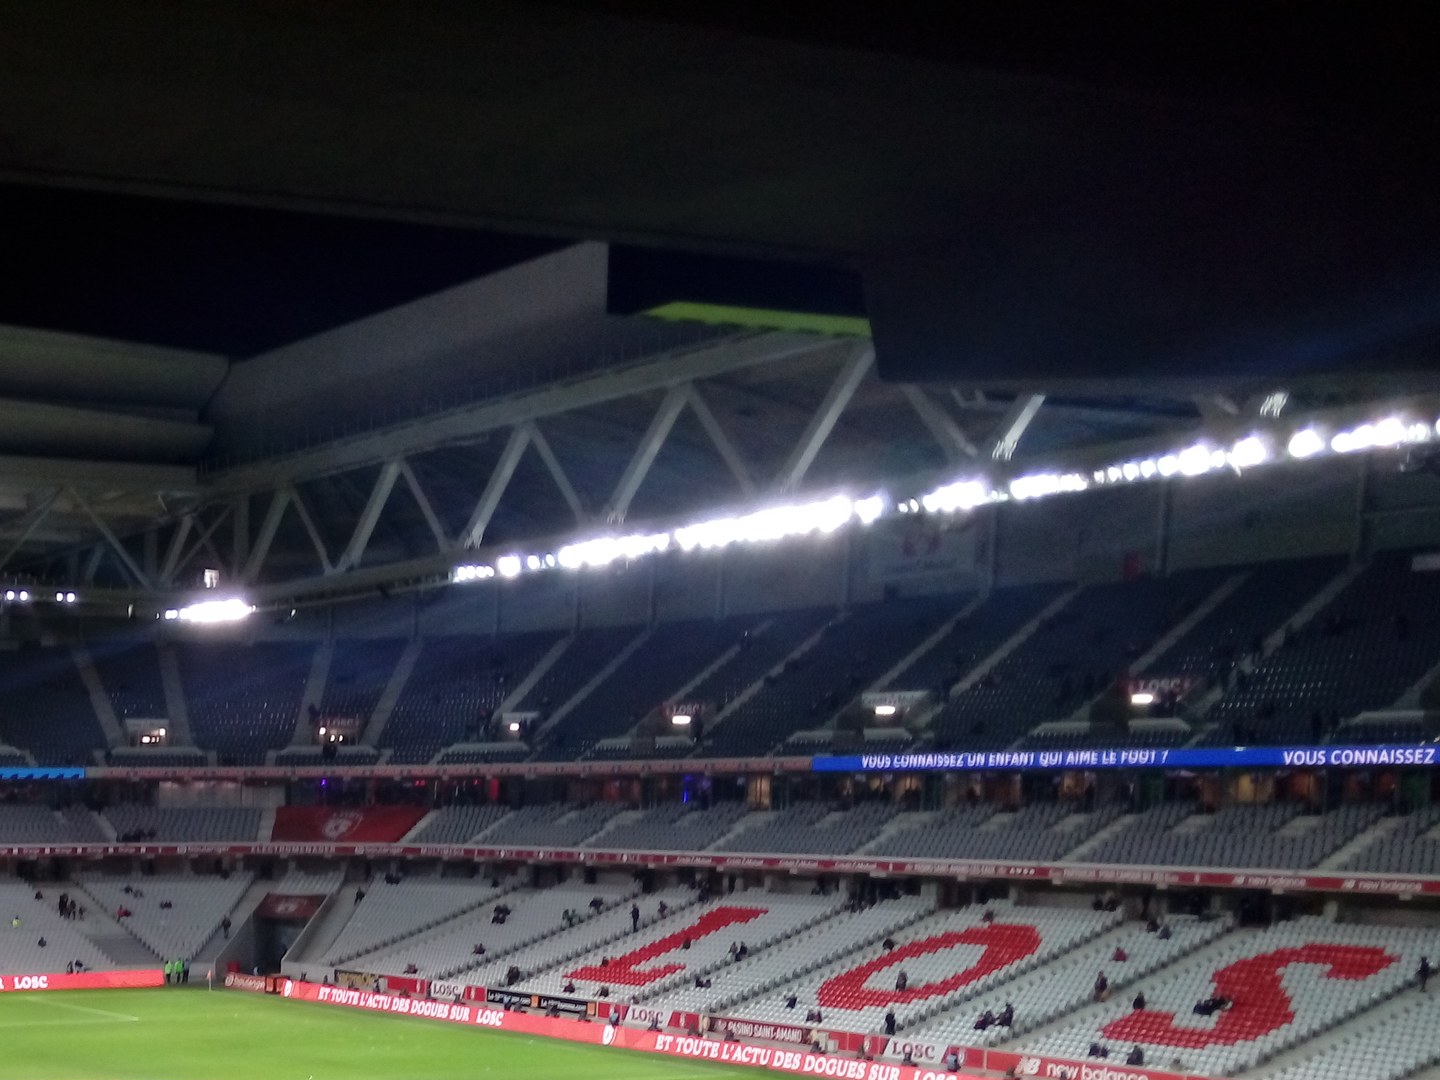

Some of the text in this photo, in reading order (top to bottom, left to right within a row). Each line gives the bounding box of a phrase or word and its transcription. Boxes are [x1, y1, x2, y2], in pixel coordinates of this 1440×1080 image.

[862, 755, 890, 768] VOUS
[967, 752, 985, 766] UN
[988, 752, 1034, 767] ENFANT
[1040, 751, 1062, 766] QUI
[1065, 751, 1098, 765] AIME
[1101, 750, 1117, 765] LE
[1121, 750, 1156, 764] FOOT
[1284, 748, 1435, 765] VOUS CONNAISSEZ
[1380, 881, 1422, 892] balance
[13, 976, 48, 990] LOSC
[430, 981, 460, 997] LOSC
[318, 986, 504, 1026] ET TOUTE L'ACTU DES DOGUES SUR LOSC
[630, 1007, 664, 1024] LOSC
[654, 1033, 672, 1051] ET
[675, 1037, 719, 1059] TOUTE
[721, 1043, 771, 1067] L'ACTU
[772, 1051, 801, 1071] DES
[802, 1056, 866, 1080] DOGUES
[891, 1041, 936, 1061] LOSC
[1046, 1061, 1079, 1079] new
